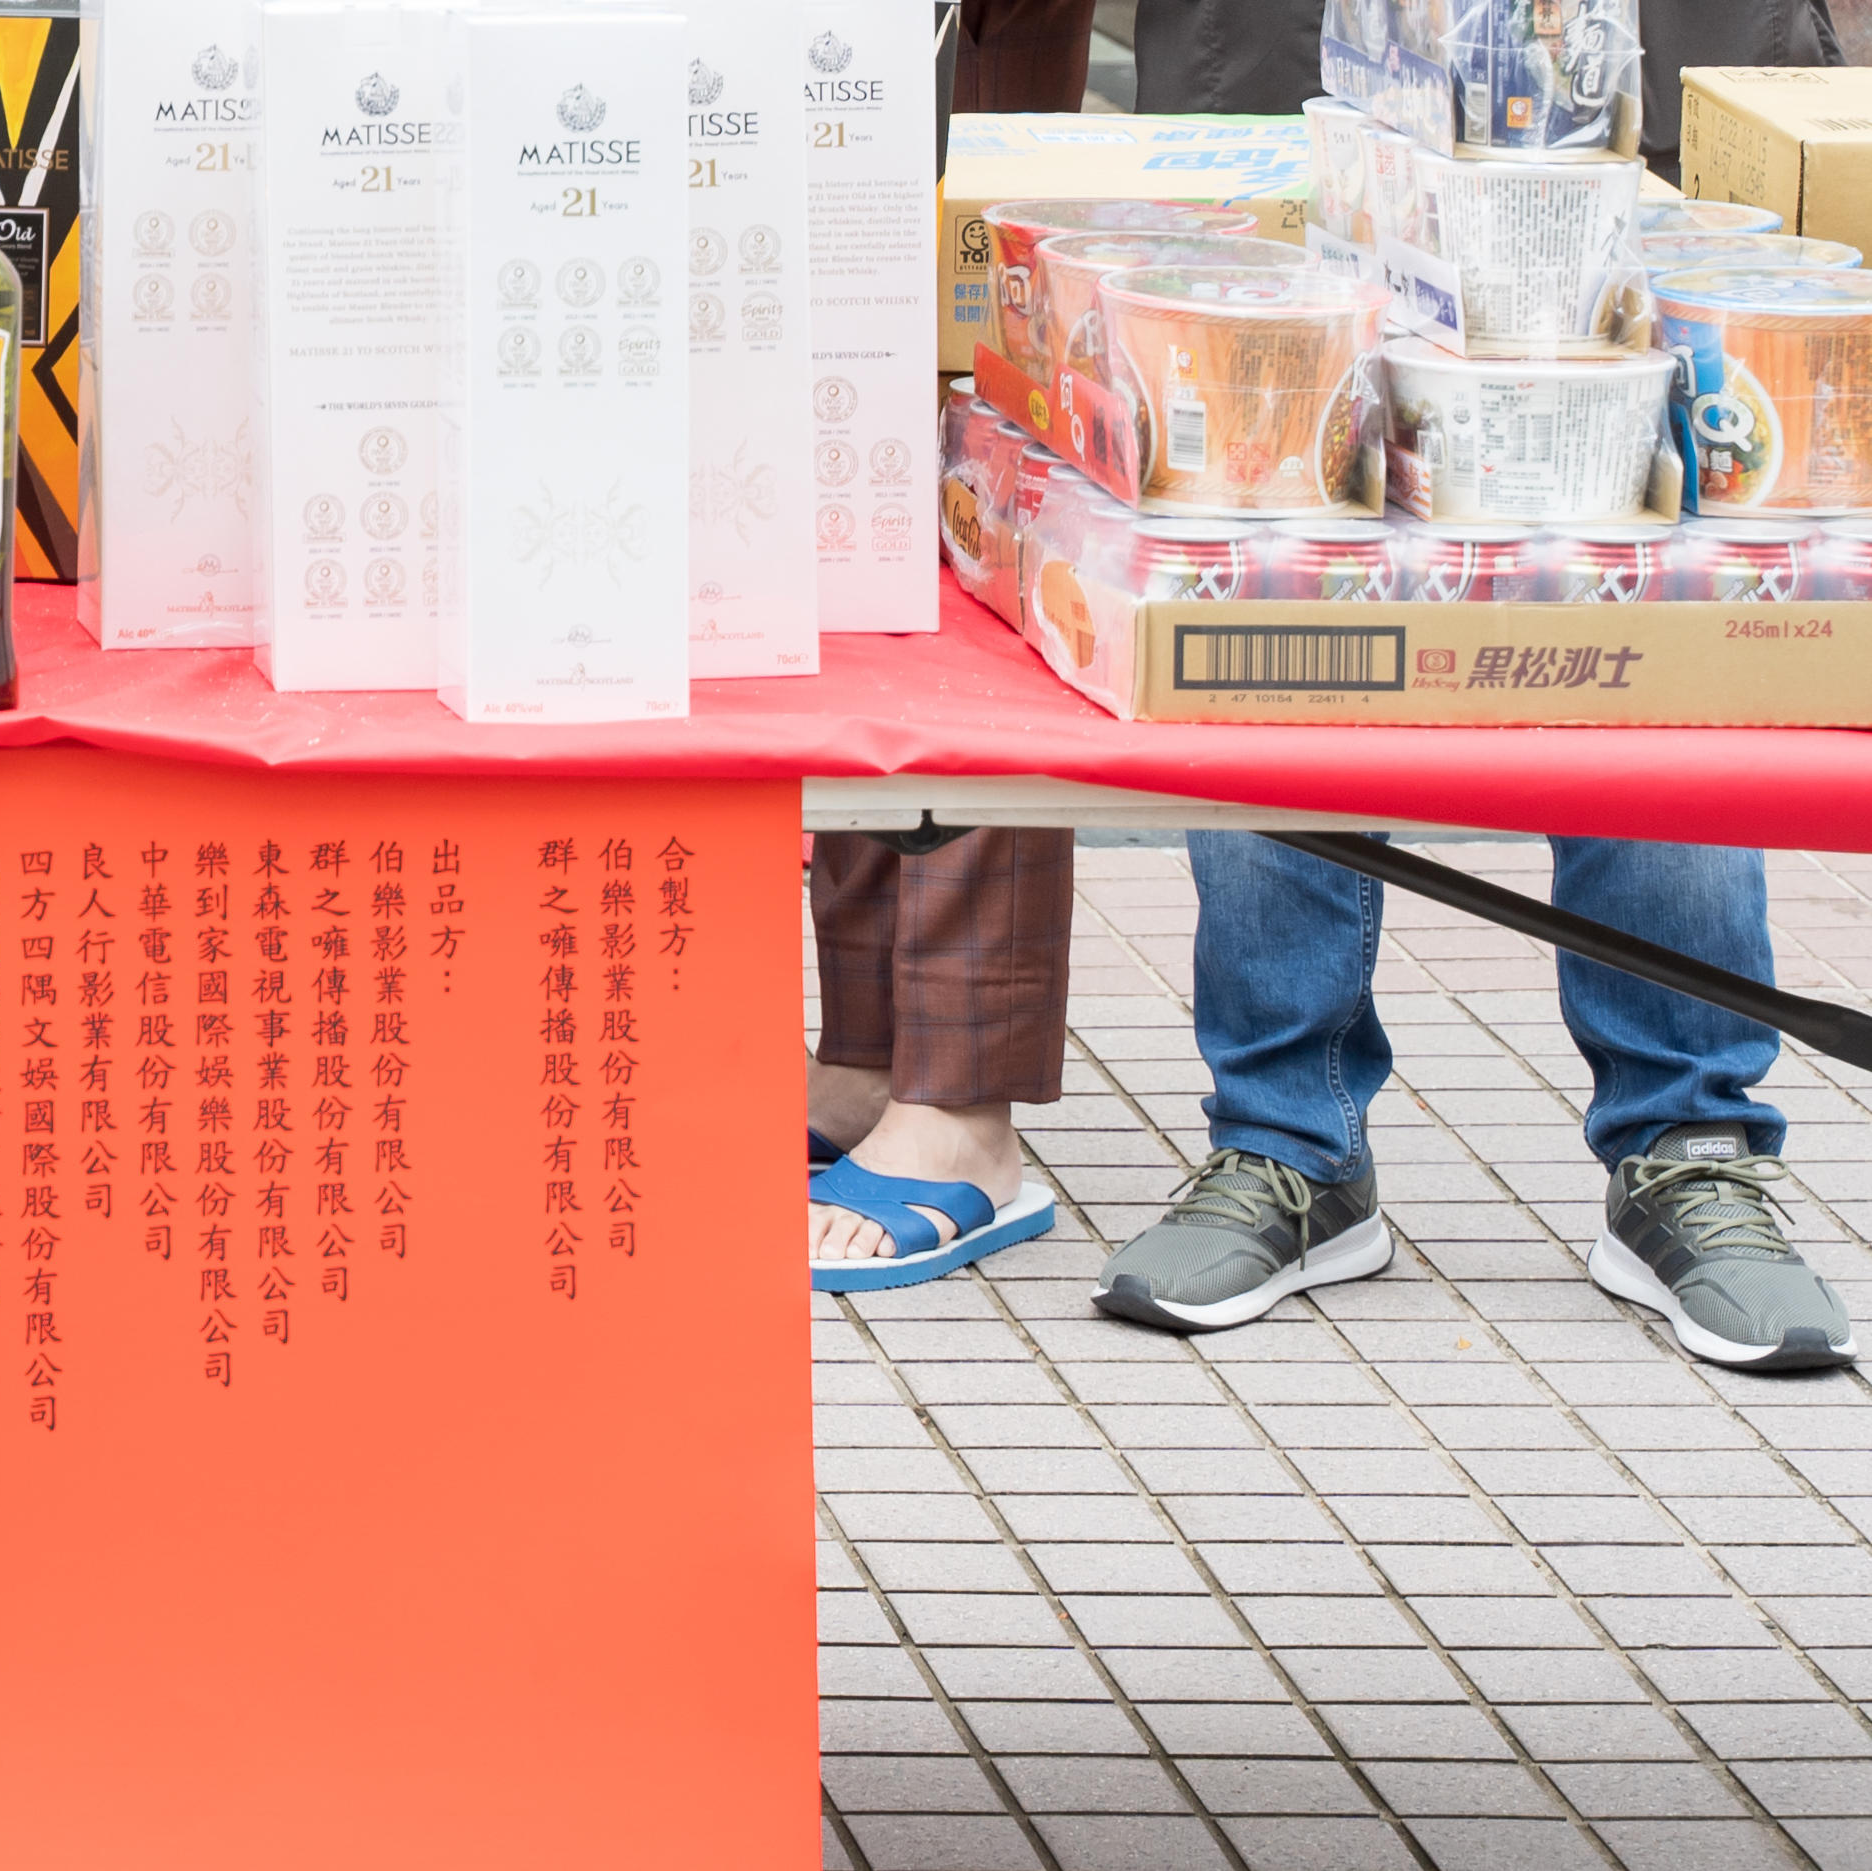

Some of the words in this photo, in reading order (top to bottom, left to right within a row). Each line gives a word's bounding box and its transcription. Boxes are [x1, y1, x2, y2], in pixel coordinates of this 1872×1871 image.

[804, 80, 884, 102] ATISSE
[320, 123, 432, 147] MATISSE
[813, 122, 848, 148] 21
[849, 133, 873, 142] Years
[195, 142, 233, 172] 21
[518, 140, 641, 165] MATISSE
[361, 165, 396, 193] 21
[530, 201, 556, 213] Aged
[562, 187, 600, 217] 21
[602, 201, 628, 211] Years
[1466, 645, 1644, 691] 黑松沙士
[1231, 694, 1247, 704] 47
[78, 842, 117, 1219] 良人行影業有限公司
[136, 841, 177, 1261] 中華電信股份有限公司
[369, 840, 412, 1259] 伯樂影業股份有限公司
[598, 838, 641, 1257] 伯樂影業股份有限公司
[253, 839, 295, 1345] 東森電視事業股份有限公司
[195, 841, 237, 1388] 樂到家國際娛樂股份有限公司
[20, 851, 62, 1432] 四方四隅文娛國際股份有限公司
[1691, 1141, 1735, 1156] adidas
